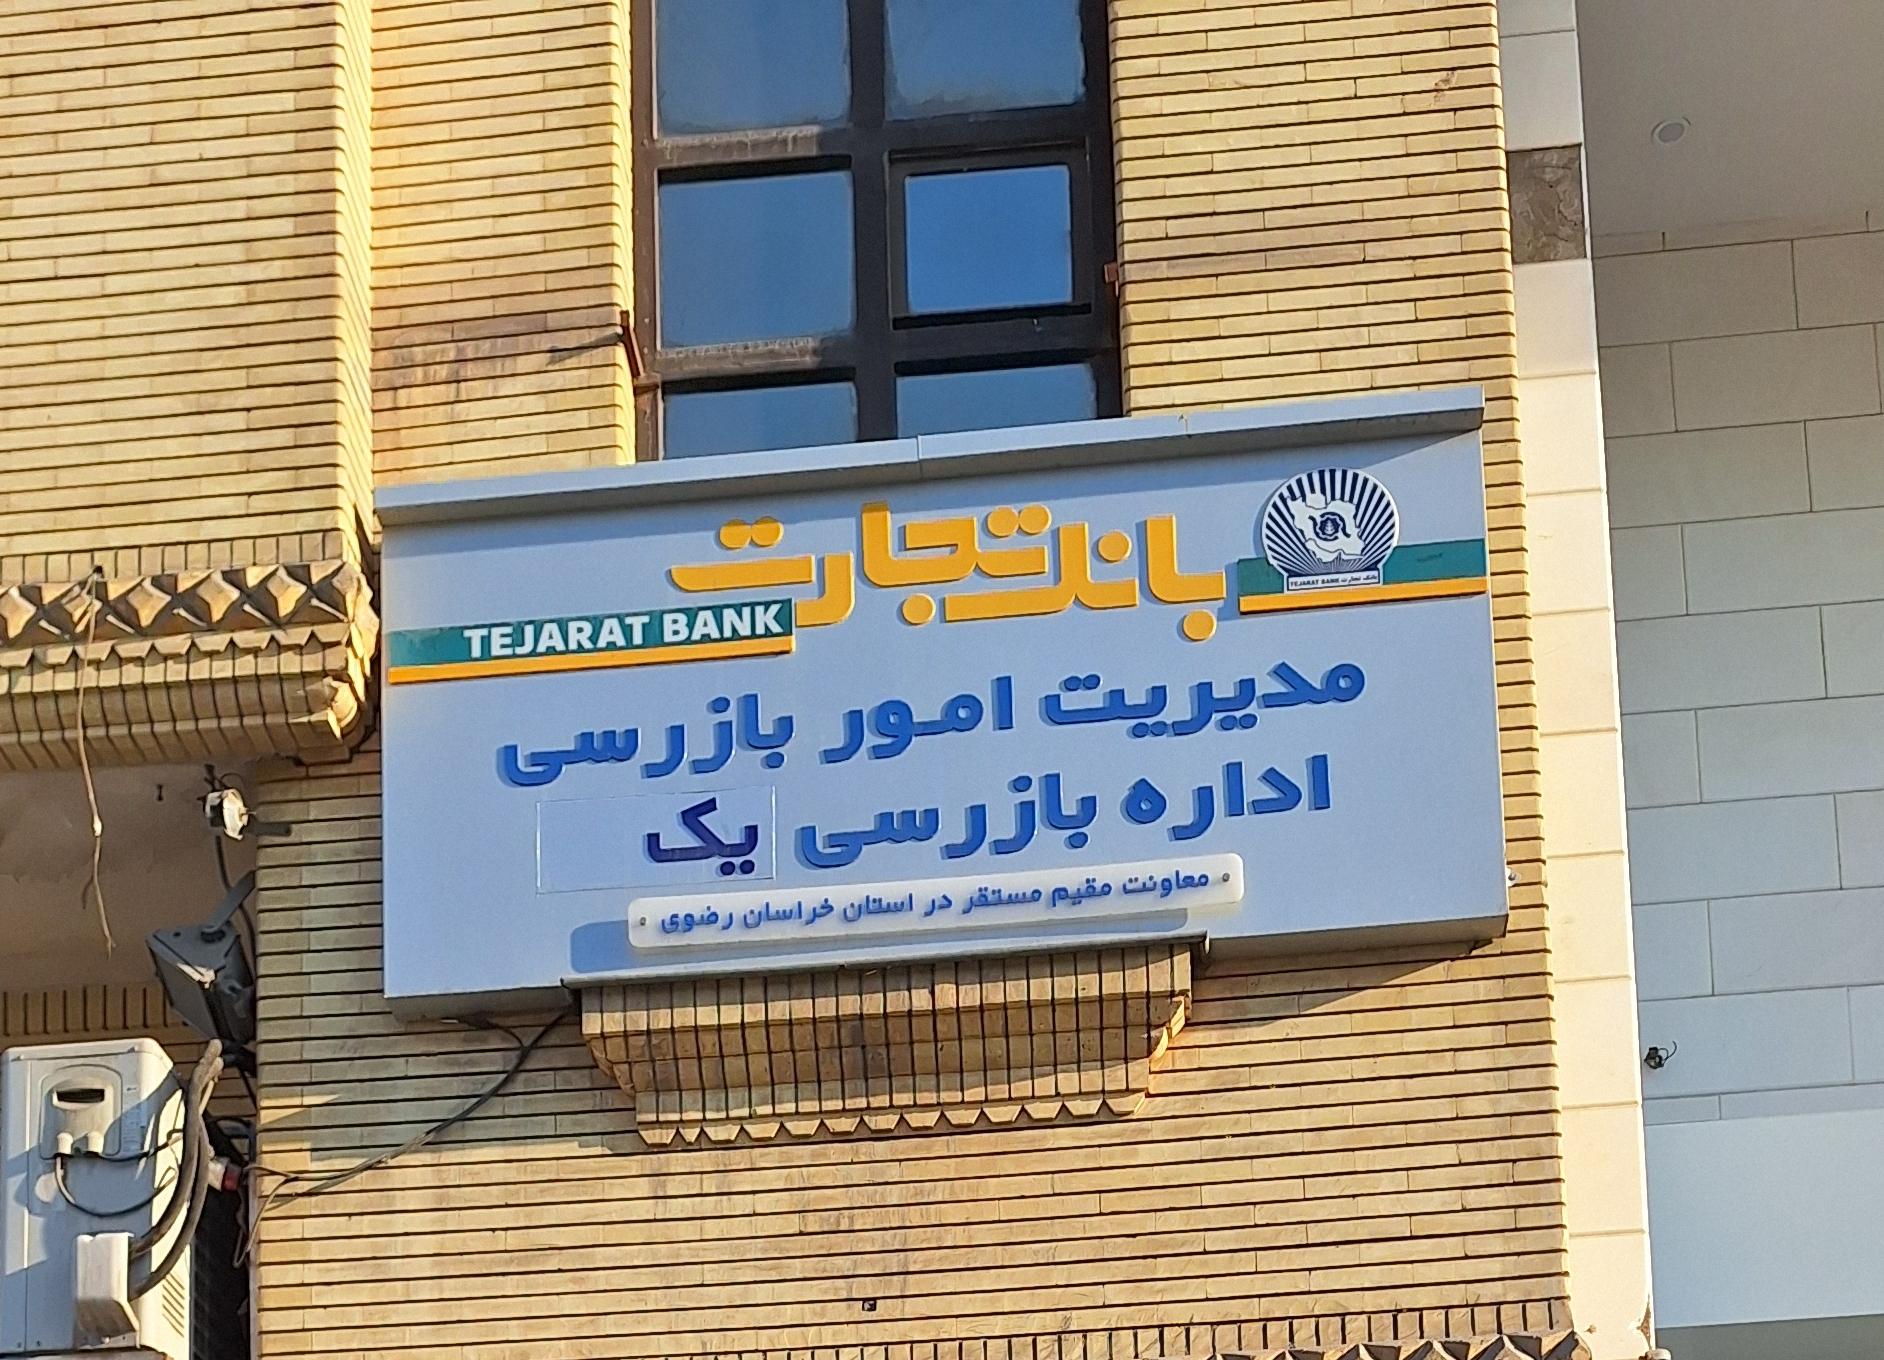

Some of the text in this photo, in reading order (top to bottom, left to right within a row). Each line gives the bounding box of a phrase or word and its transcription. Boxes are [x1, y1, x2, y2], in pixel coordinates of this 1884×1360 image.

[463, 603, 784, 659] TEJARAT BANK
[671, 502, 1226, 641] بانک تجارت
[499, 660, 1366, 787] مدیریت امور بازرسی
[646, 753, 1331, 877] اداره بازرسی یک
[660, 869, 1210, 934] معاونت مقیم مستقر در استان خراسان رضوی
